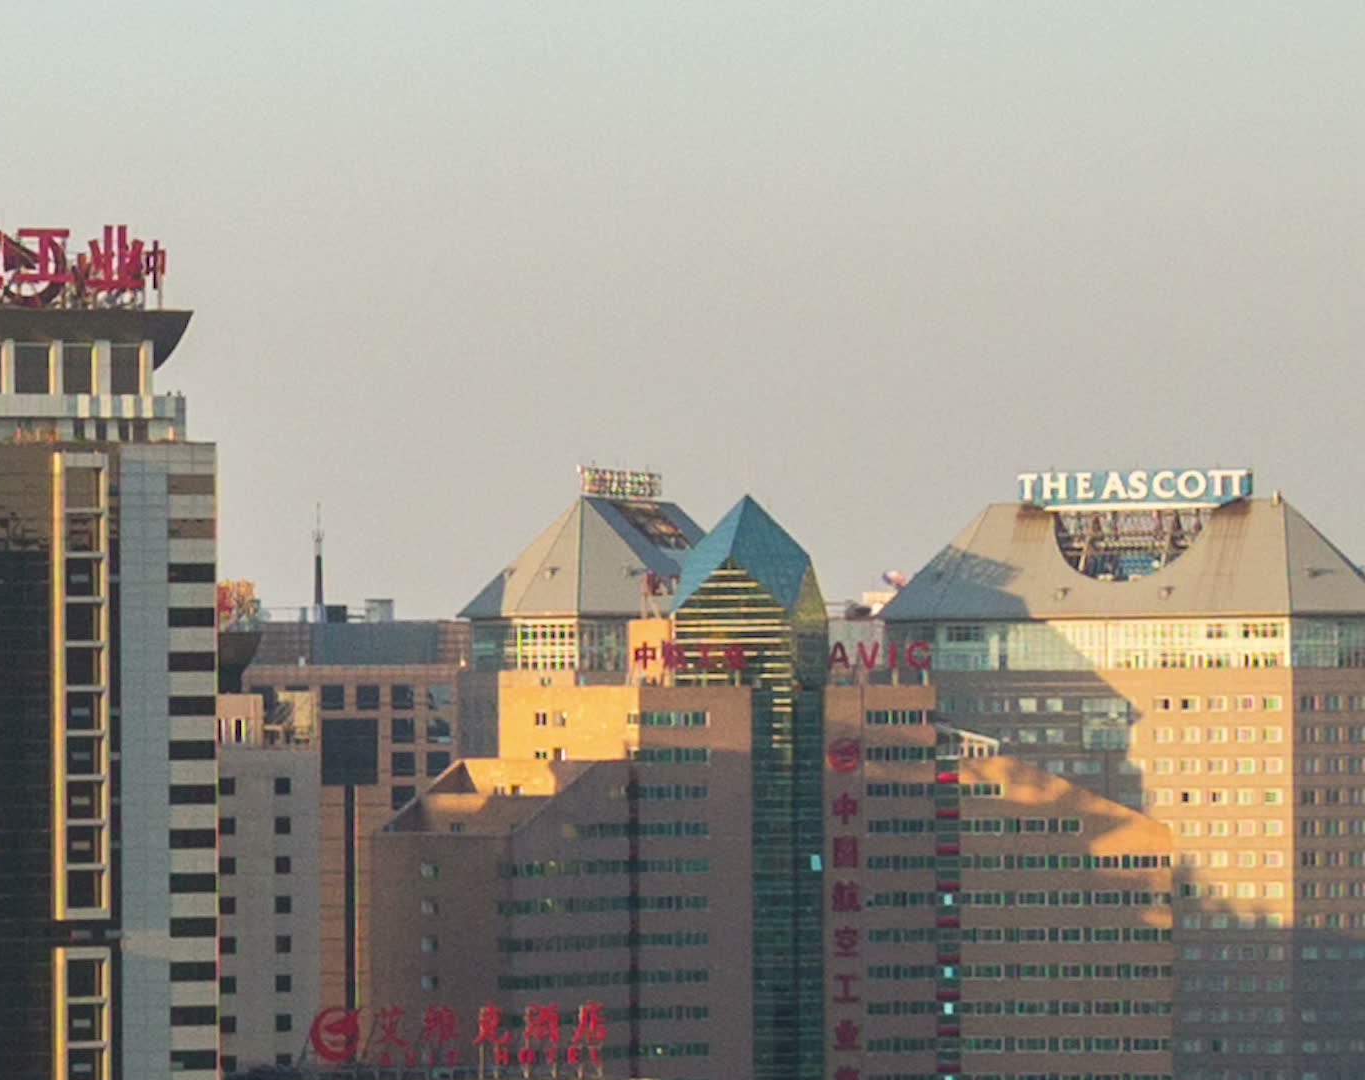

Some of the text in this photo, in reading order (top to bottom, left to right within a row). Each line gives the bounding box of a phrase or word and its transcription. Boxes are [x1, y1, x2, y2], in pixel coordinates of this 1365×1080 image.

[1017, 468, 1248, 500] THE ASCOTT
[827, 640, 933, 672] AVIC
[493, 1045, 604, 1066] HOTEL
